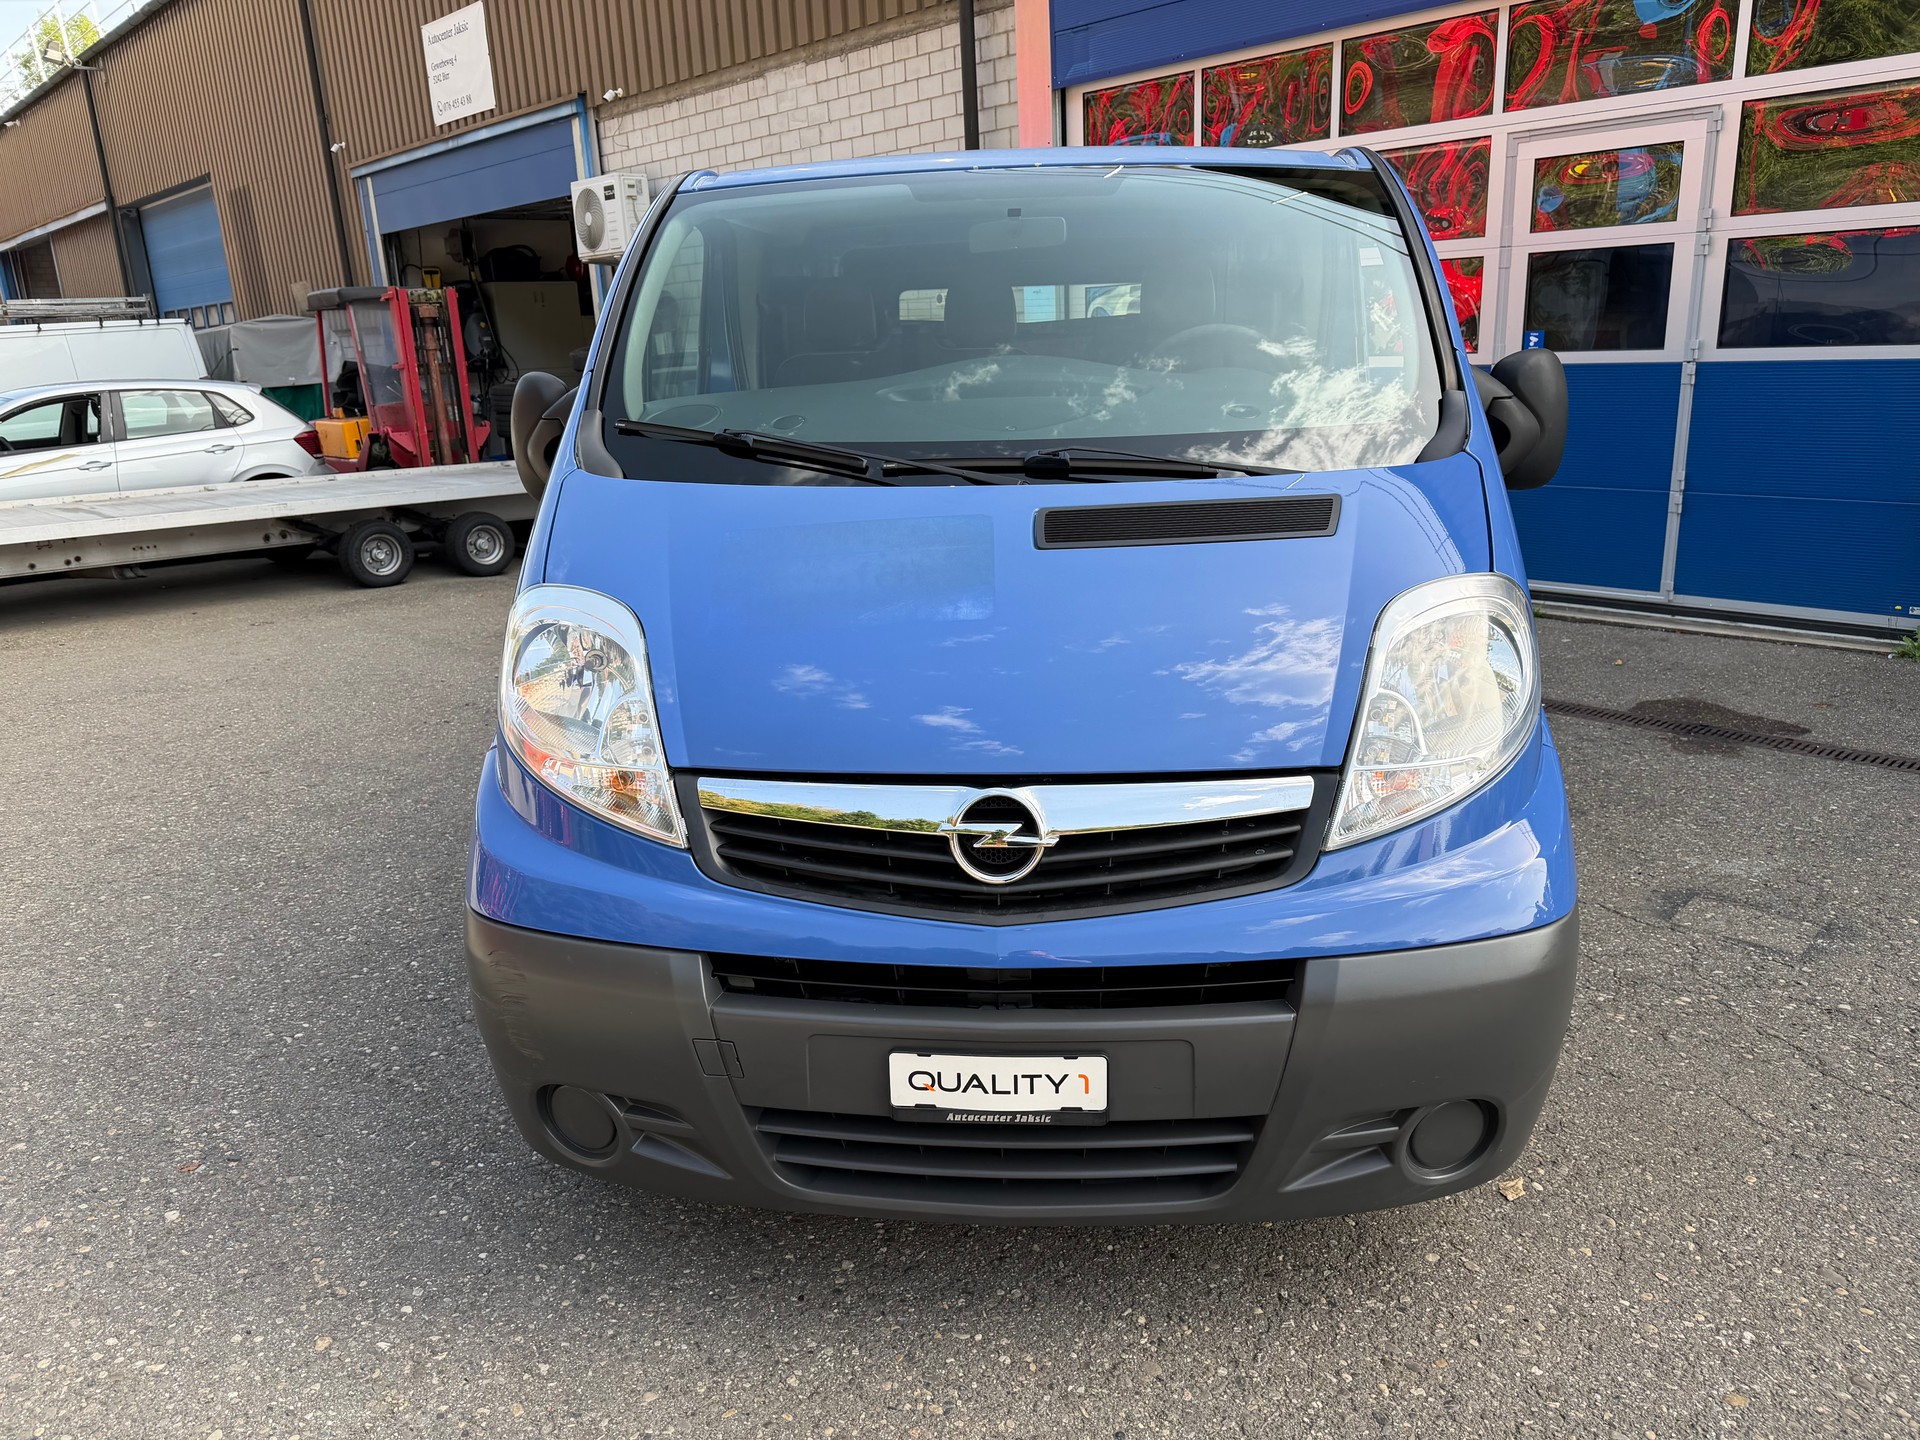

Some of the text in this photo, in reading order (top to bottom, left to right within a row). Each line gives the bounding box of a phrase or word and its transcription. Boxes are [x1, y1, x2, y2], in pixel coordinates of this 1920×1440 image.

[427, 29, 453, 46] Autocenter
[908, 1071, 1069, 1094] QUALITY
[946, 1112, 1052, 1123] Autocenter Jaksic
